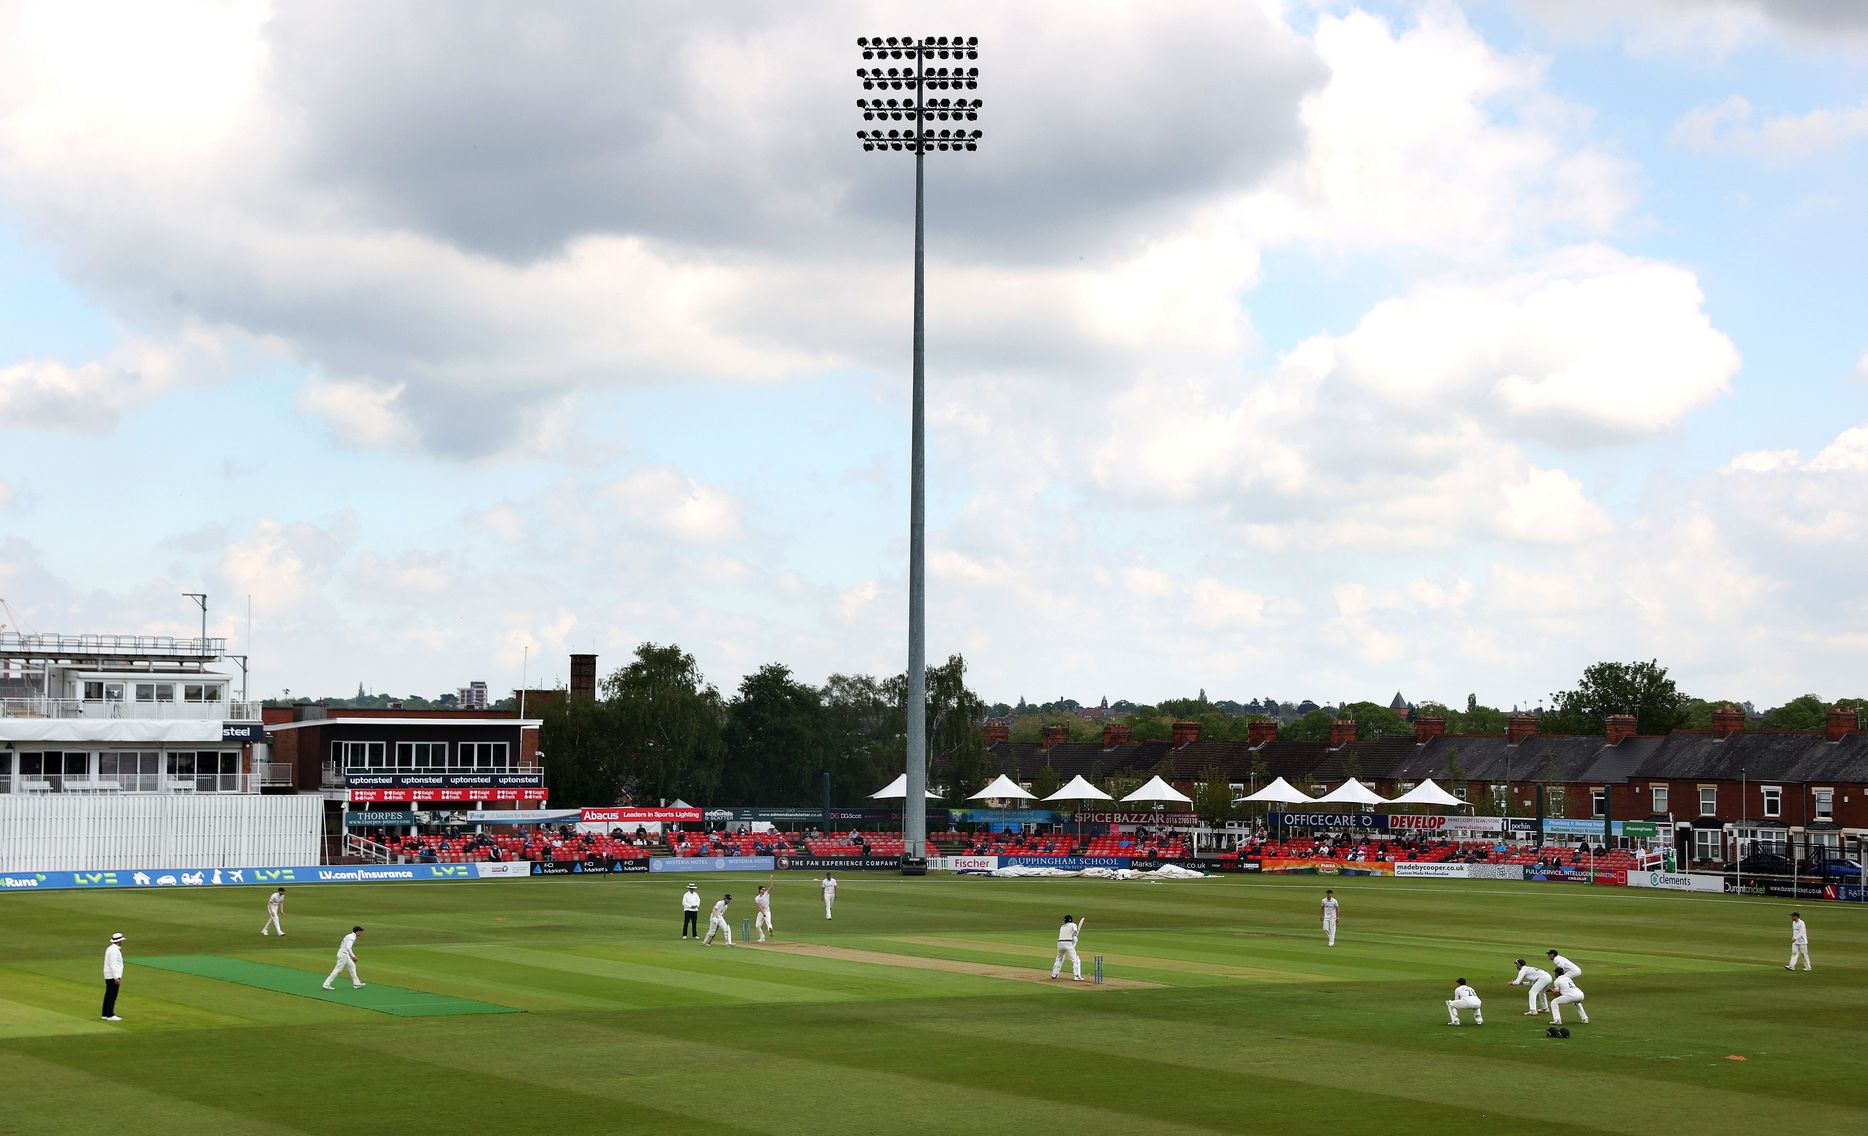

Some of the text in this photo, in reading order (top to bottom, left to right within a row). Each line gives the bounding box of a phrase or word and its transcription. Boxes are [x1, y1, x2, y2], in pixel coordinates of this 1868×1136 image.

[223, 727, 250, 736] steel
[350, 776, 393, 785] uptonsteel
[401, 776, 442, 785] uptonsteel
[358, 812, 403, 820] THORPES
[584, 811, 619, 820] Abacus
[1074, 812, 1165, 823] SPICE BAZZAR
[1284, 814, 1356, 826] OFFICECARE
[1390, 816, 1446, 829] DEVELOP
[955, 859, 989, 868] Fischer
[1131, 860, 1206, 869] MarksEleical.co.uk
[319, 870, 413, 880] LV.com/insurance
[1659, 875, 1691, 886] clements
[1770, 886, 1822, 894] www.durantricket.co.uk
